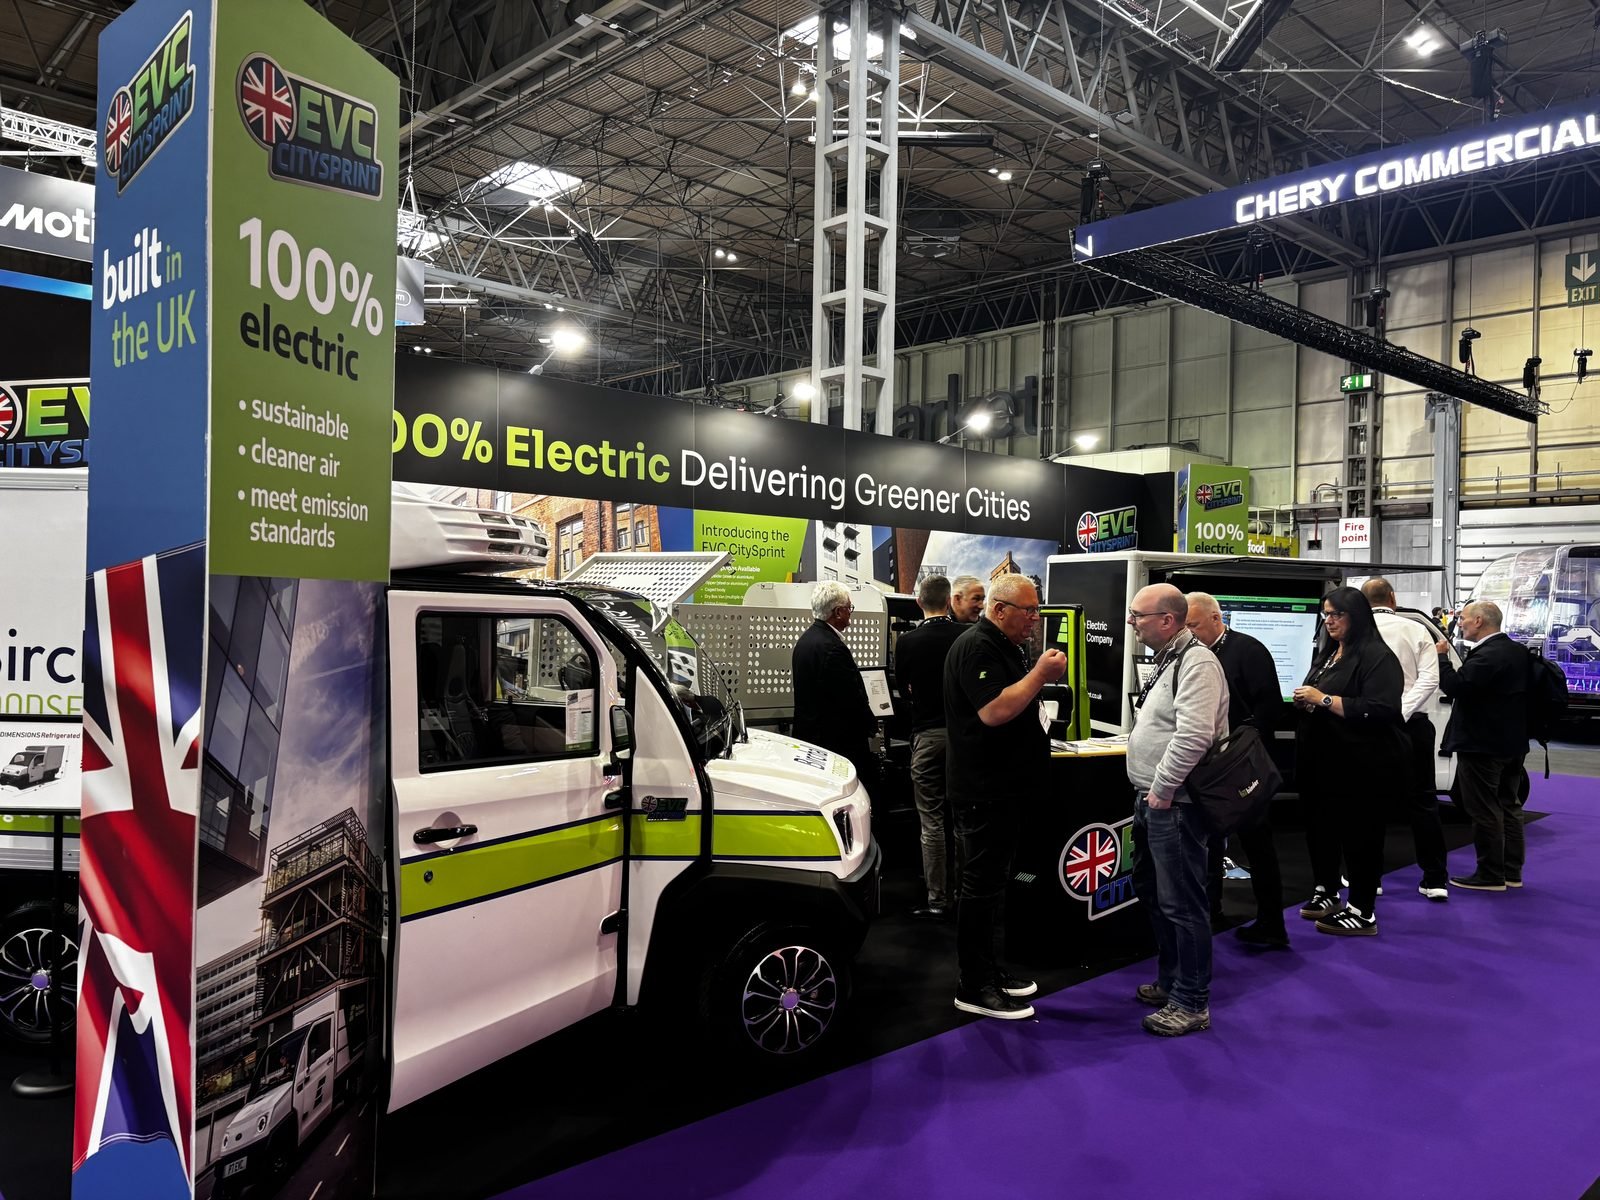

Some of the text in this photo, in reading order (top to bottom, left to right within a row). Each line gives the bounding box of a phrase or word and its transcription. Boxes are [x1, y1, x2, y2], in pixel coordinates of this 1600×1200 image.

[133, 20, 189, 134] EVC
[121, 76, 191, 181] CITYSPRINT
[298, 86, 374, 160] EVC
[276, 143, 379, 192] CITYSPRINT
[1235, 114, 1600, 223] CHERY COMMERCIAL
[102, 227, 182, 310] built in
[239, 216, 384, 336] 100%
[1571, 286, 1597, 302] EXIT
[112, 289, 197, 368] the UK
[240, 303, 359, 381] electric
[252, 398, 349, 441] sustainable
[251, 437, 341, 478] cleaner air
[506, 426, 671, 482] Electric
[681, 449, 846, 510] Delivering
[854, 473, 960, 515] Greener
[965, 486, 1031, 522] Cities
[250, 485, 368, 522] meet emission
[1213, 482, 1240, 499] EVC
[250, 516, 336, 548] standards
[702, 523, 790, 543] Introducing the
[1099, 509, 1135, 540] EVC
[1195, 522, 1244, 542] 100%
[1341, 533, 1367, 544] point
[1344, 523, 1365, 531] Fire
[729, 543, 785, 559] CitySprint
[1088, 534, 1136, 553] CITYSPRINT
[1194, 541, 1235, 555] electric
[1248, 539, 1266, 554] food
[1086, 620, 1108, 631] Electric
[1086, 633, 1114, 647] Company
[0, 628, 84, 684] irc
[41, 732, 81, 740] Refrigerated
